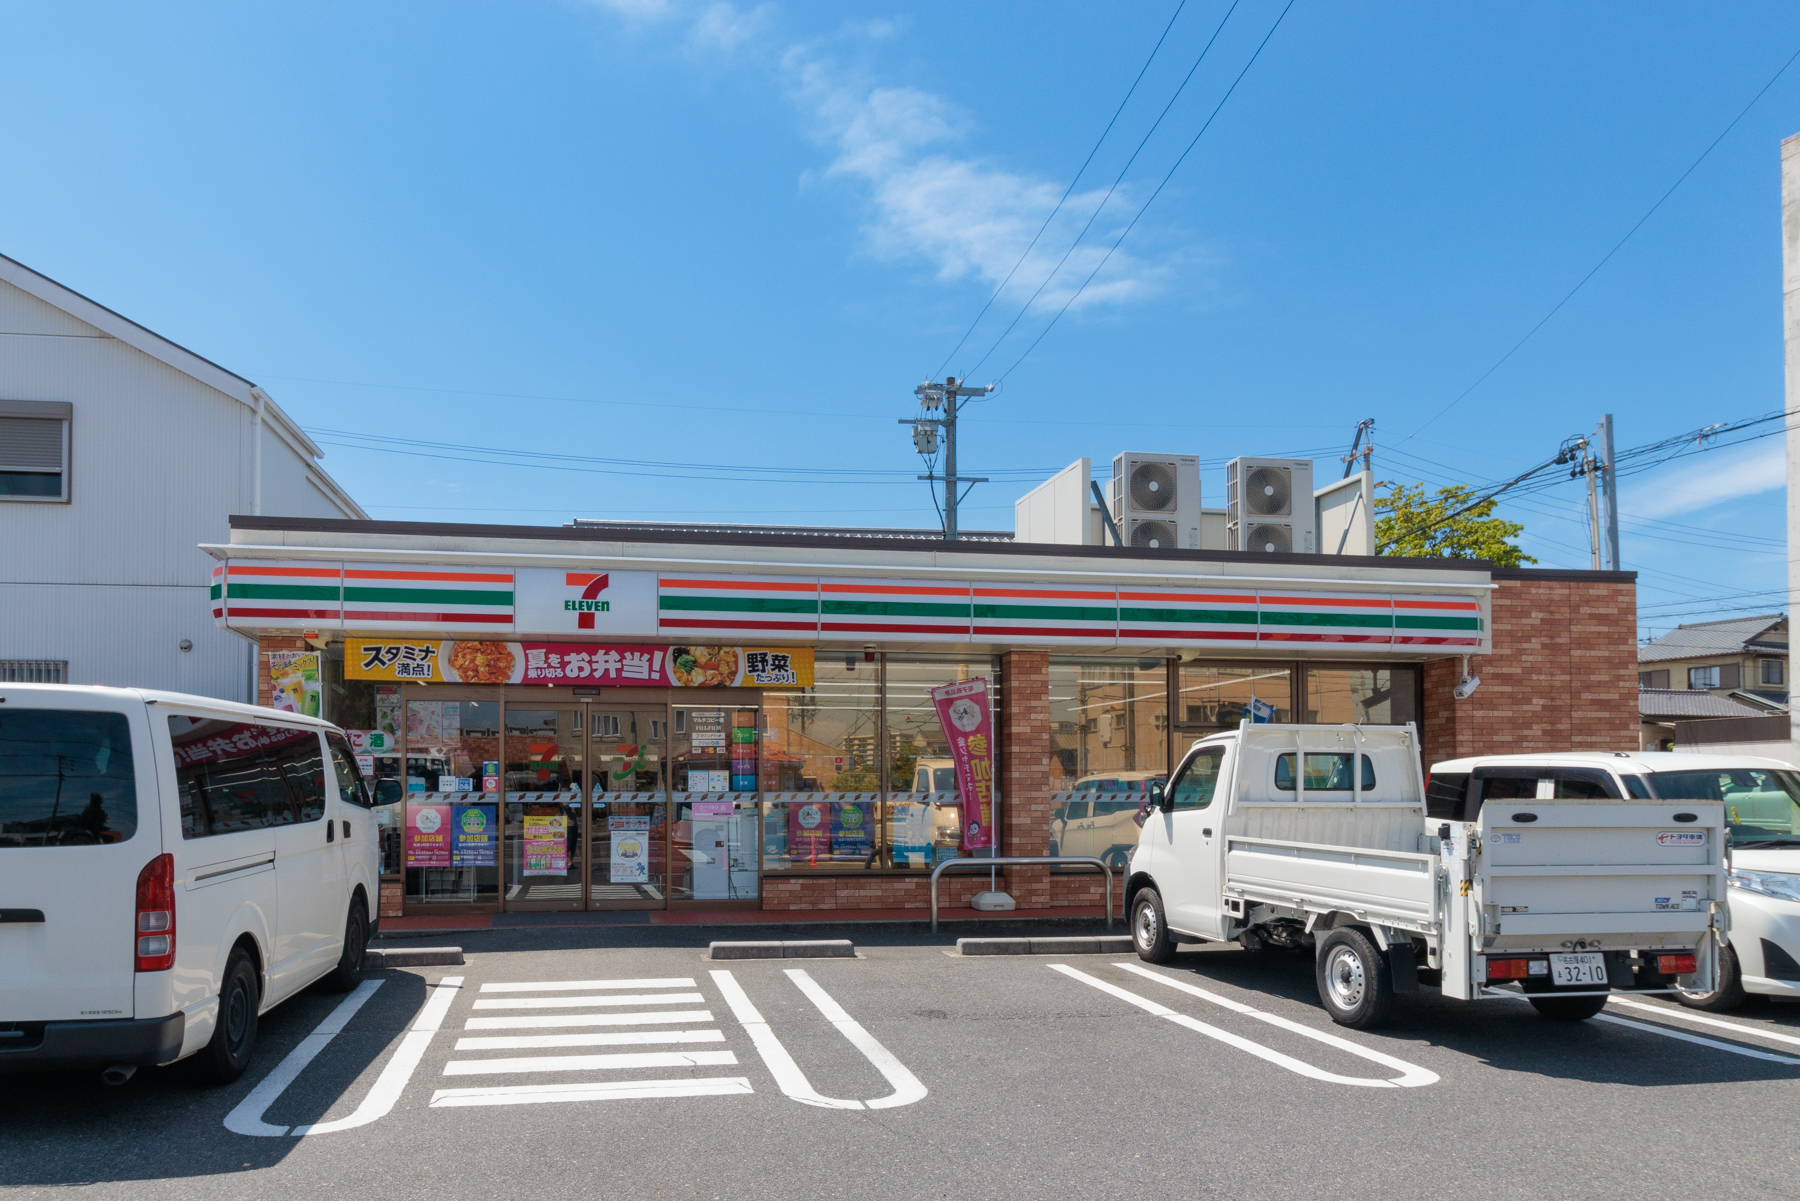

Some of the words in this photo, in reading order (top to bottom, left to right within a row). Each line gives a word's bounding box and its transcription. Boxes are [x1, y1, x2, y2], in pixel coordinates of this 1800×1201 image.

[362, 646, 436, 669] スタミナ
[526, 649, 561, 668] 夏を
[746, 652, 790, 673] 野菜
[396, 664, 431, 677] 満点!
[563, 650, 664, 680] お弁当!
[528, 668, 564, 678] 乗り切る
[756, 670, 796, 683] たっぷり!
[370, 733, 384, 747] 酒
[1563, 955, 1580, 964] 名古屋
[1580, 956, 1592, 964] 401
